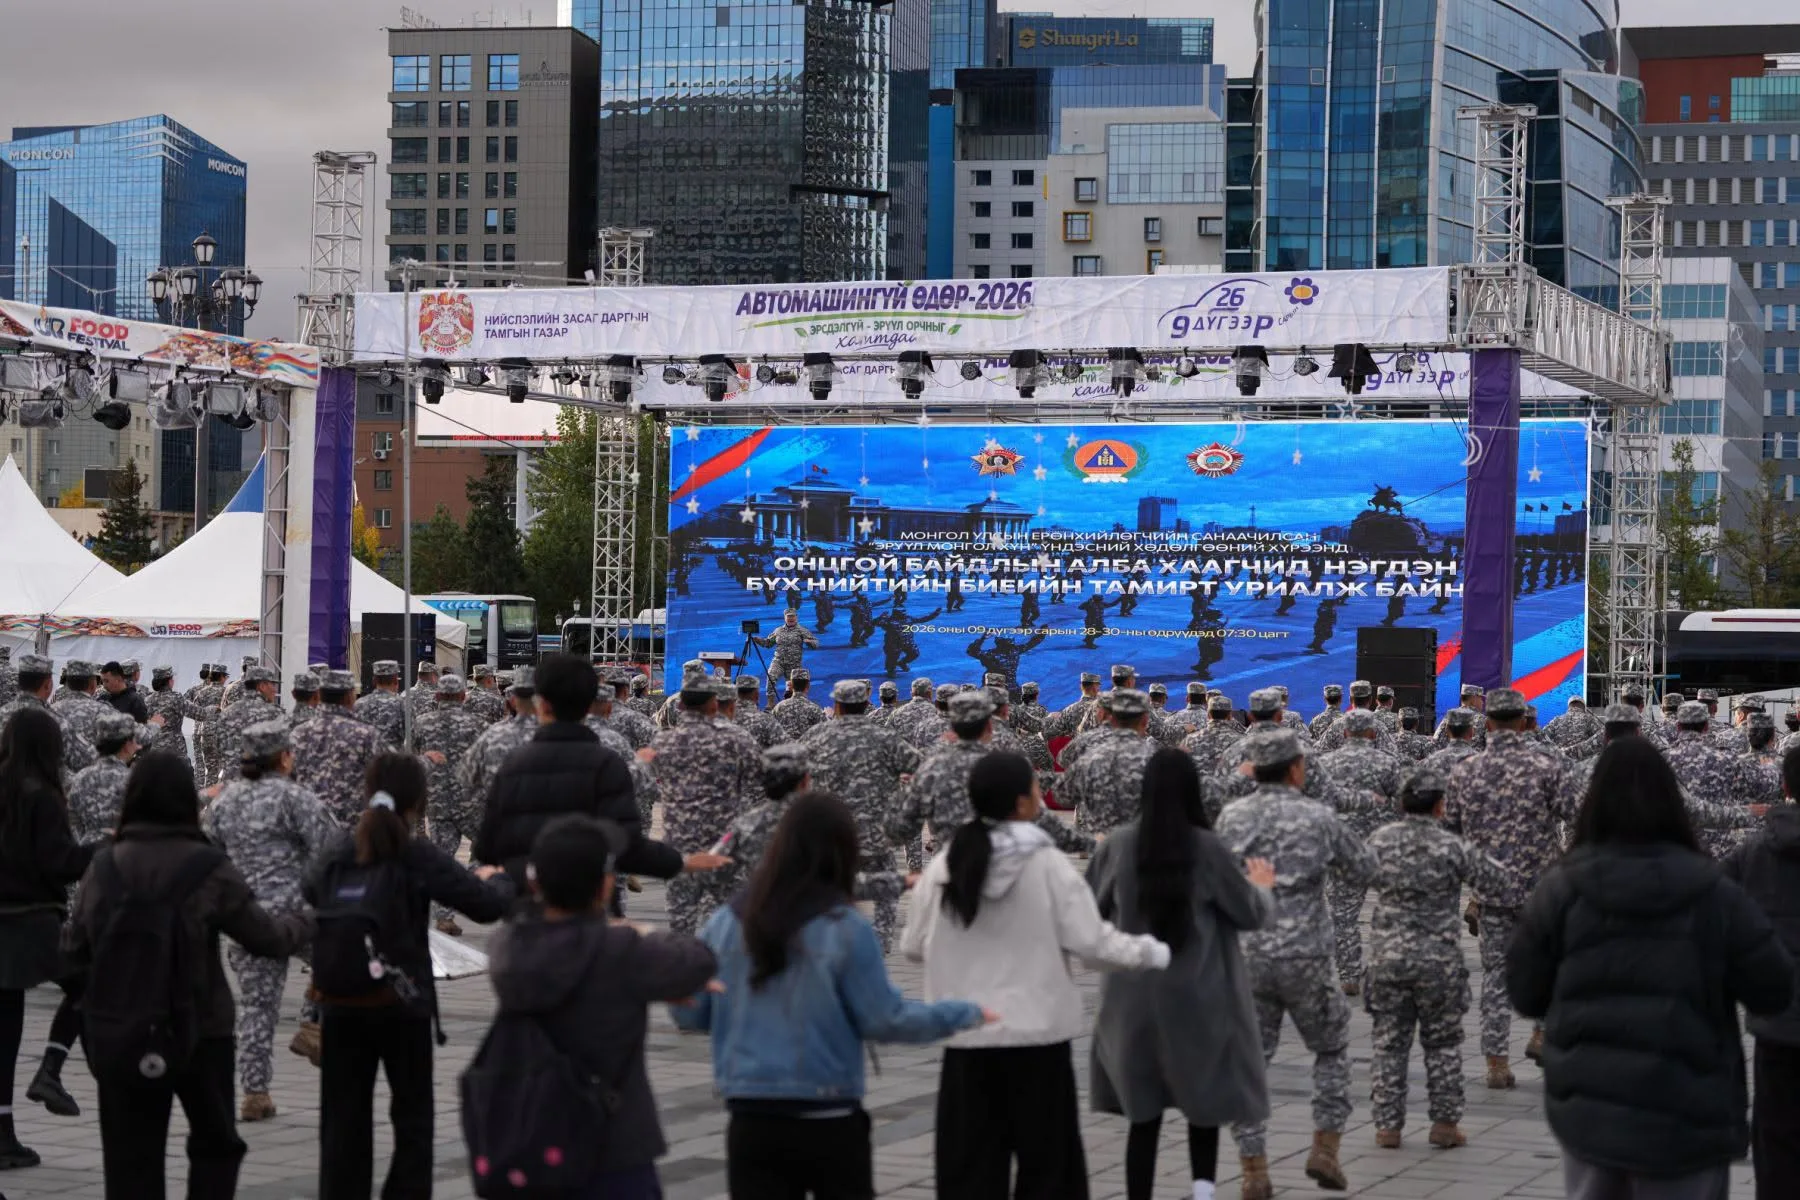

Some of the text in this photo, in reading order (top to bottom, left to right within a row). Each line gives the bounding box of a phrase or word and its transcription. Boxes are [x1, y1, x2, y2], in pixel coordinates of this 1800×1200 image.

[9, 149, 74, 160] MONCON
[208, 158, 245, 177] MONCON
[736, 281, 1033, 316] АВТОМАШИНГҮЙ ӨДӨР-2026
[1216, 287, 1245, 307] 26
[70, 317, 129, 340] FOOD
[485, 312, 649, 326] НИЙСЛЭЛИЙН ЗАСАГ ДАРГЫН
[810, 319, 863, 335] ЭРСДЭЛГҮЙ
[873, 320, 903, 332] ЭРҮҮЛ
[906, 320, 946, 332] ОРЧНЫГ
[1171, 315, 1190, 339] 9
[67, 332, 131, 352] FESTIVAL
[485, 327, 568, 338] ТАМГЫН ГАЗАР
[900, 531, 969, 540] МОНГОЛ
[1032, 530, 1188, 541] ЕРӨНХИЙЛӨГЧИЙН
[1191, 532, 1317, 541] САНААЧИЛСАН
[927, 542, 995, 550] МОНГОЛ
[1041, 541, 1131, 552] ҮНДЭСНИЙ
[1134, 541, 1265, 553] ХӨДӨЛГӨӨНИЙ
[1268, 543, 1349, 554] ХҮРЭЭНД
[773, 553, 1457, 577] ОНЦГОЙ БАЙДЛЫН АЛБА ХААГЧИД НЭГДЭН
[746, 574, 1464, 598] БҮХ НИЙТИЙН БИЕИЙН ТАМИРТ УРИАЛЖ БАЙН
[902, 624, 935, 633] 2026
[967, 625, 986, 634] 09
[986, 627, 1032, 637] дүгээр
[1034, 627, 1077, 636] сарын
[1079, 627, 1147, 636] 28-30-ны
[1147, 629, 1215, 639] өдрүүдэд
[1216, 629, 1256, 638] 07:30
[1258, 631, 1290, 639] цагт
